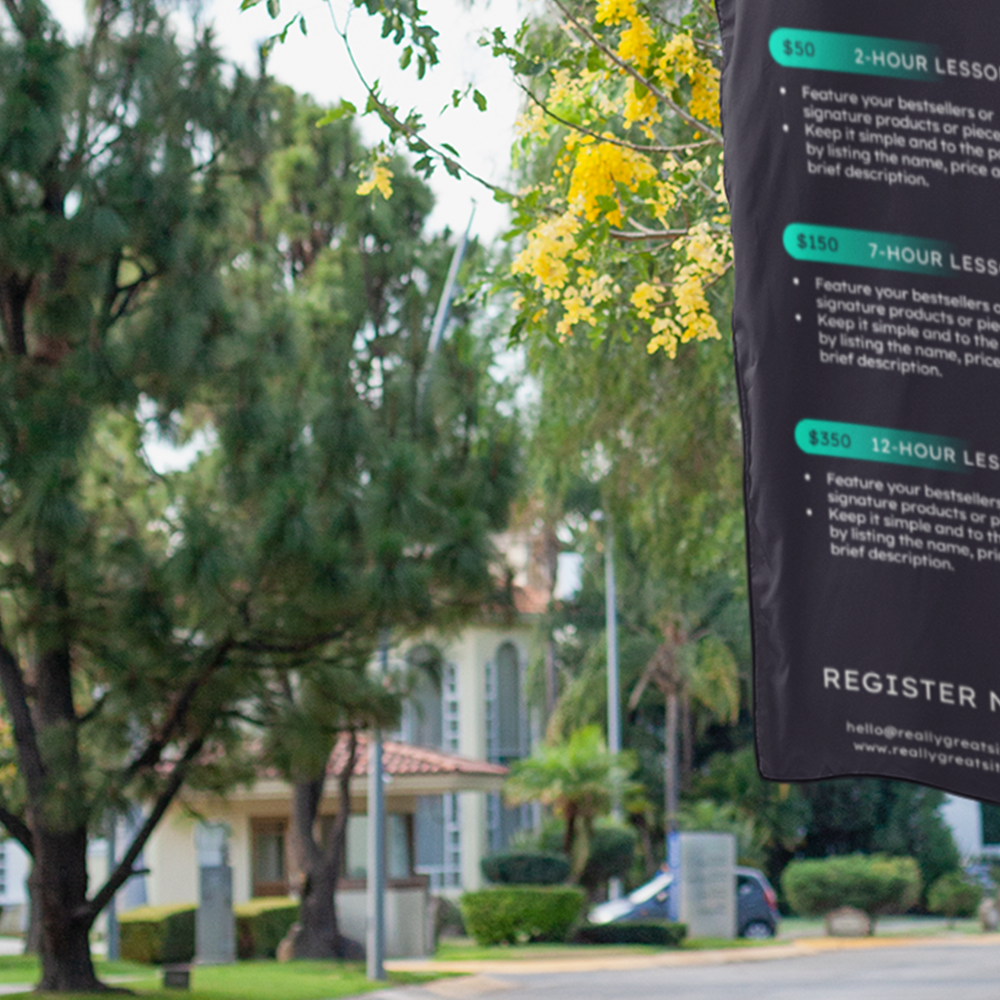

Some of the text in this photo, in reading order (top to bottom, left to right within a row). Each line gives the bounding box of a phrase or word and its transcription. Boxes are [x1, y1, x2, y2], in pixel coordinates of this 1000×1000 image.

[782, 39, 815, 57] $50
[854, 48, 928, 72] 2-HOUR
[802, 85, 994, 122] Feature your bestsellers or
[803, 104, 872, 125] signature
[875, 115, 940, 134] products
[943, 122, 959, 135] or
[805, 123, 842, 141] Keep
[846, 127, 855, 141] it
[859, 129, 906, 150] simple
[909, 137, 937, 151] and
[940, 139, 956, 154] to
[959, 141, 984, 158] the
[806, 142, 824, 159] by
[827, 144, 871, 164] listing
[874, 149, 899, 165] the
[901, 153, 948, 173] name,
[951, 160, 988, 177] price
[807, 160, 930, 187] brief description.
[796, 233, 839, 252] $150
[868, 243, 943, 268] 7-HOUR
[815, 277, 872, 296] Feature
[875, 285, 908, 300] your
[911, 289, 990, 313] bestsellers
[816, 297, 886, 317] signature
[889, 306, 954, 325] products
[957, 314, 973, 327] or
[817, 314, 855, 331] Keep
[858, 317, 868, 331] it
[872, 320, 919, 340] simple
[922, 327, 951, 342] and
[954, 330, 970, 345] to
[974, 333, 999, 349] the
[819, 331, 837, 348] by
[840, 333, 884, 353] listing
[887, 339, 911, 355] the
[915, 345, 962, 364] name,
[820, 350, 943, 378] brief description.
[808, 429, 851, 449] $350
[872, 437, 956, 463] 12-HOUR
[827, 472, 884, 491] Feature
[887, 481, 920, 496] your
[827, 491, 897, 511] signature
[901, 500, 966, 521] products
[970, 510, 986, 523] or
[829, 508, 866, 525] Keep
[870, 511, 879, 525] it
[883, 514, 931, 534] simple
[935, 522, 964, 538] and
[967, 526, 983, 541] to
[830, 525, 848, 542] by
[851, 527, 895, 547] listing
[898, 533, 923, 550] the
[927, 539, 974, 559] name,
[831, 543, 955, 571] brief description.
[823, 667, 977, 708] REGISTER
